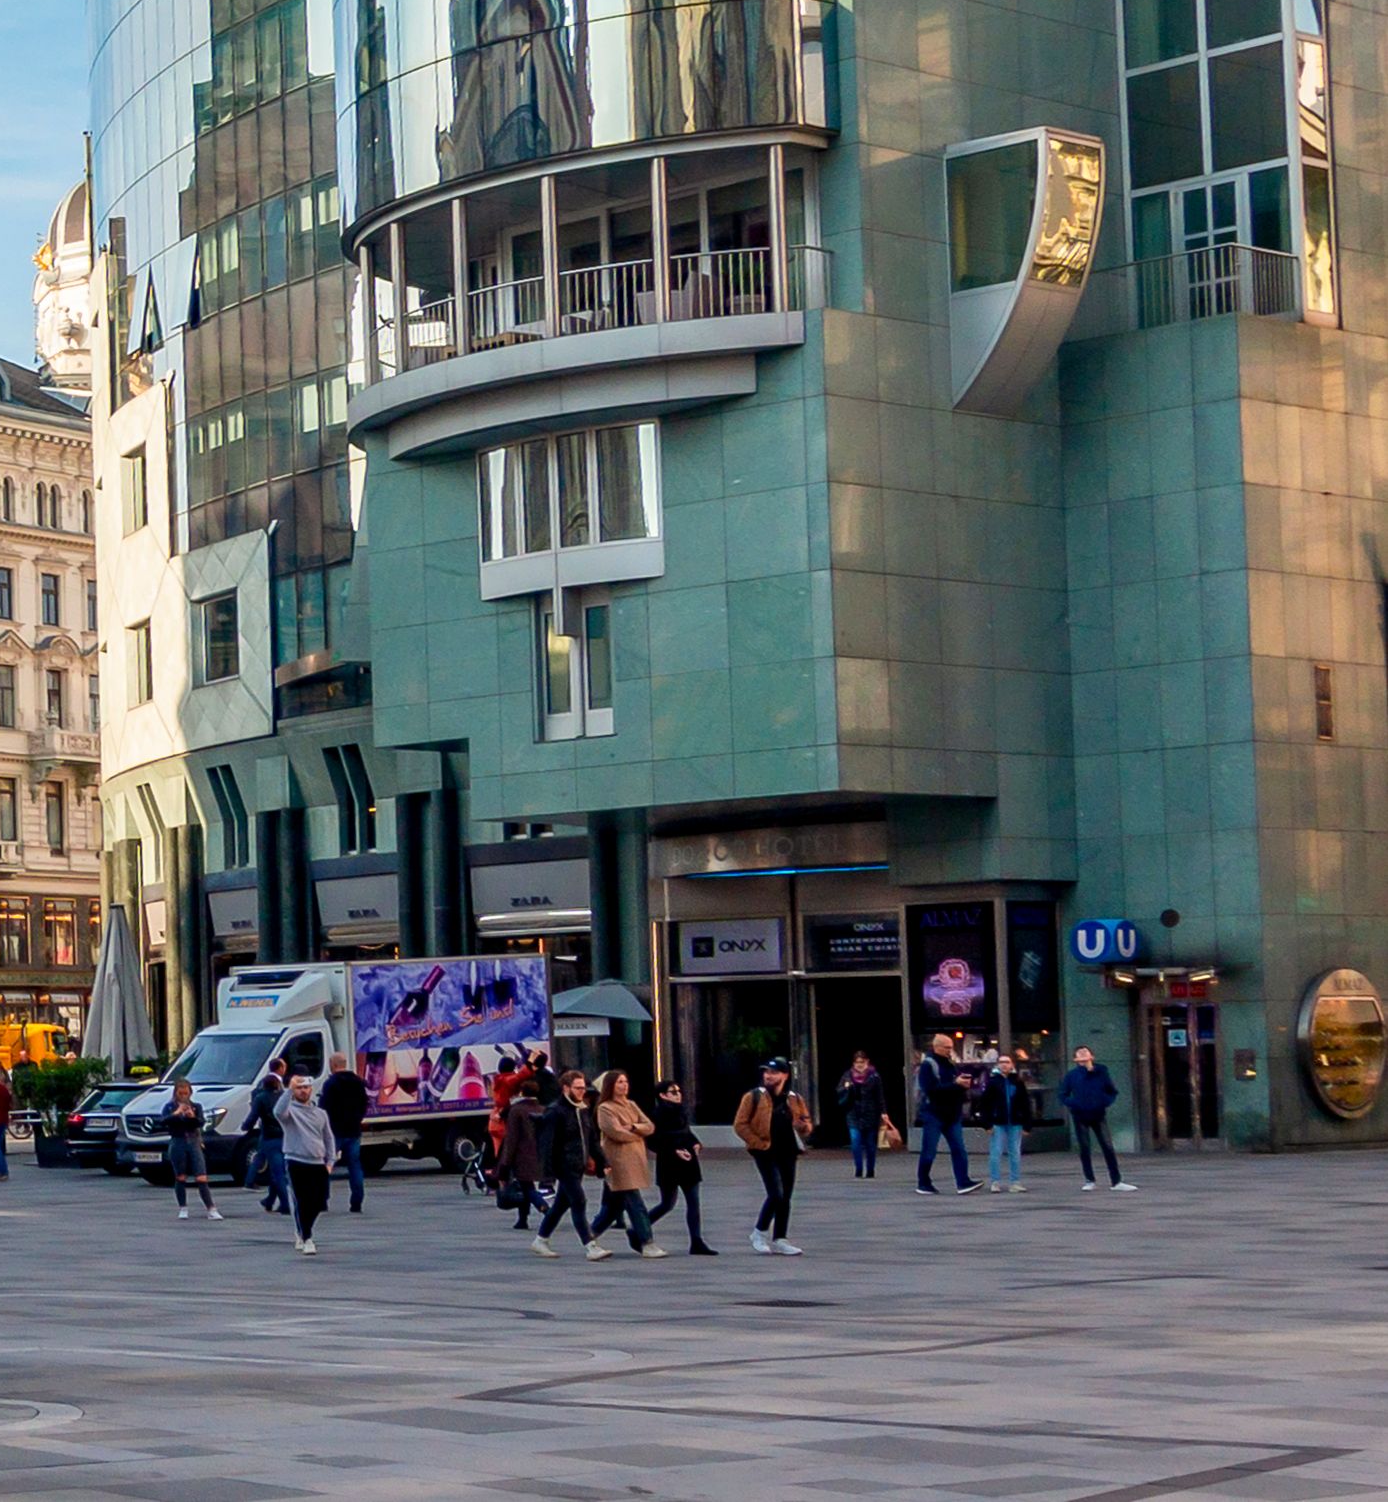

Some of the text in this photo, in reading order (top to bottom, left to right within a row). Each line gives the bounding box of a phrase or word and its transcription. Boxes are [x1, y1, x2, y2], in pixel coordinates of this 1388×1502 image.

[511, 896, 552, 907] ZARA
[347, 908, 381, 919] ZARA
[853, 922, 884, 932] ONYX
[718, 938, 766, 953] ONYX
[1077, 929, 1105, 959] U
[1117, 928, 1136, 958] U
[384, 1016, 453, 1048] Besuchen
